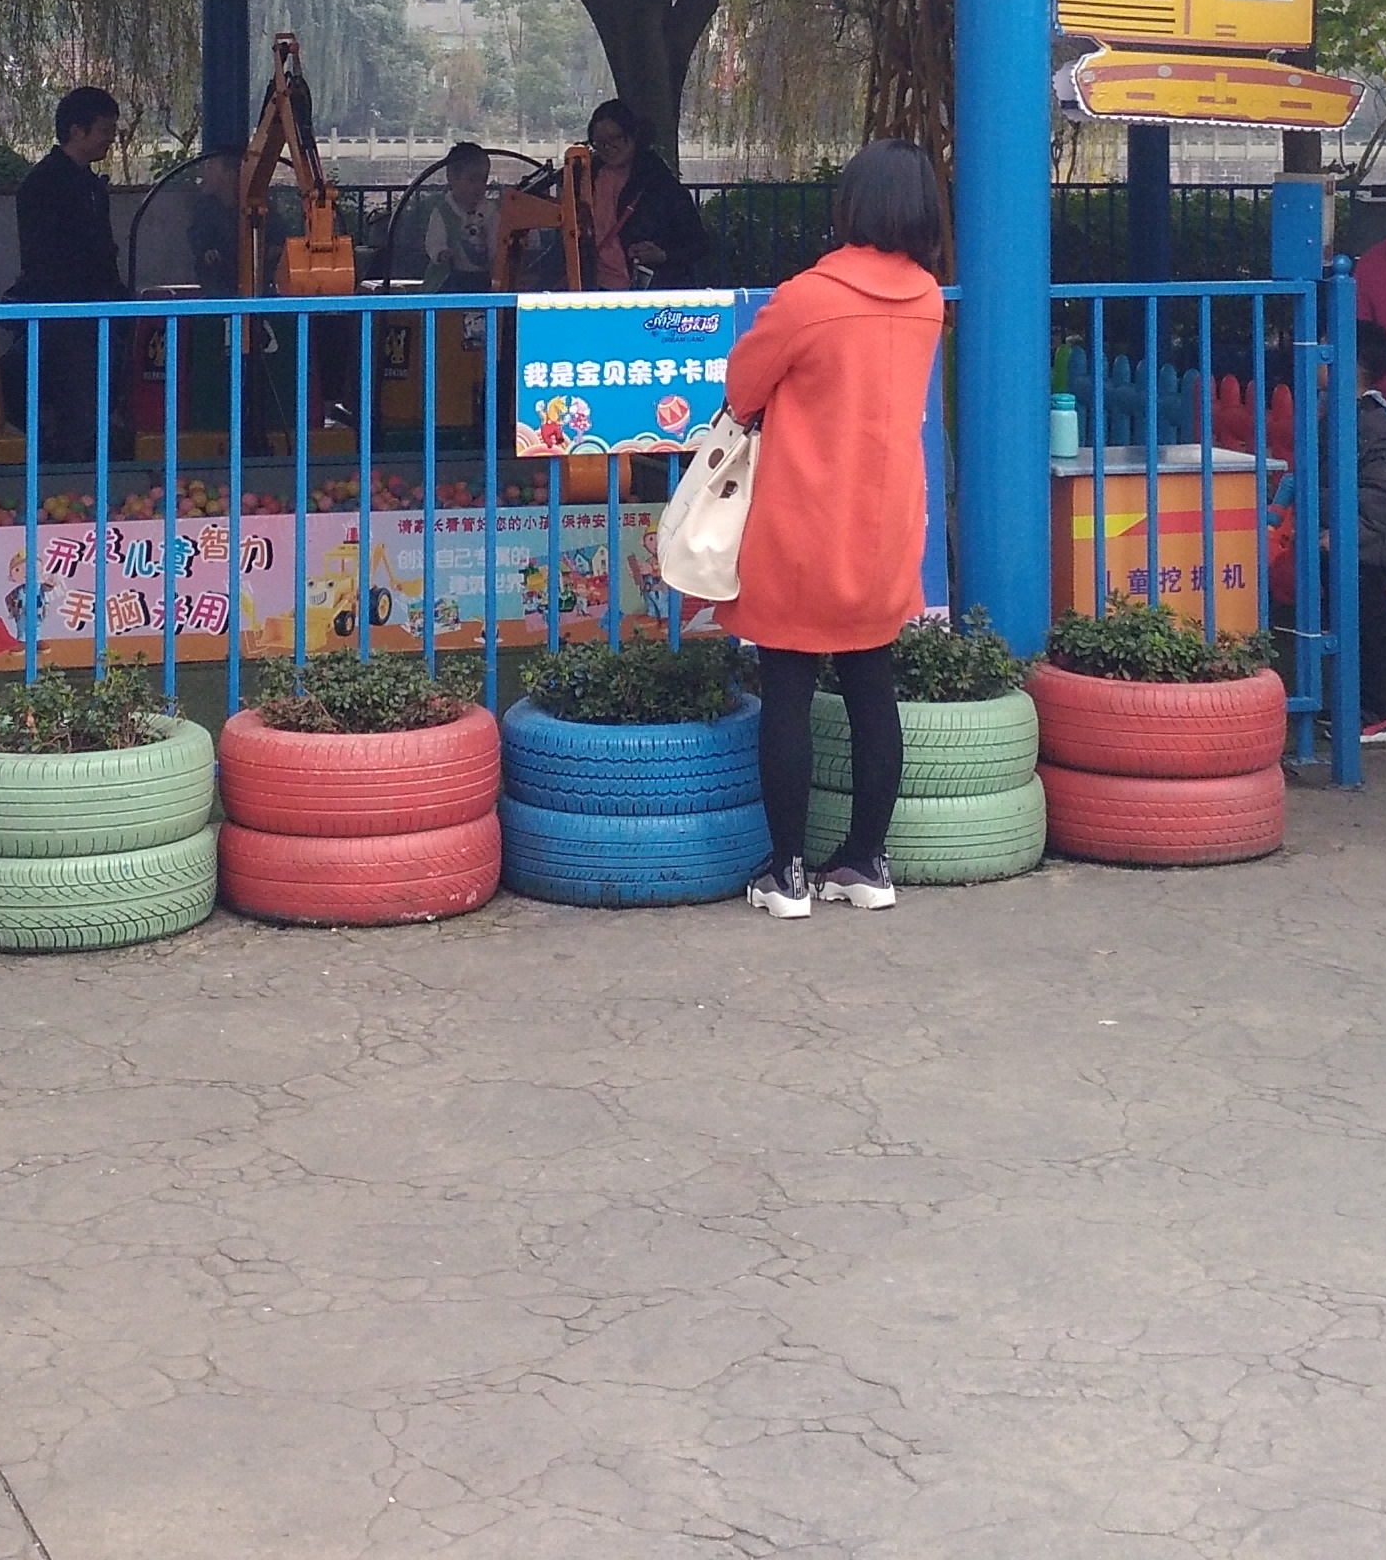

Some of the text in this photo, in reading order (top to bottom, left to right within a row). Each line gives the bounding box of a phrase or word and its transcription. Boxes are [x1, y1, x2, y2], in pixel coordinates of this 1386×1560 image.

[562, 511, 652, 529] 保持安距离
[44, 524, 272, 578] 开发儿童智力
